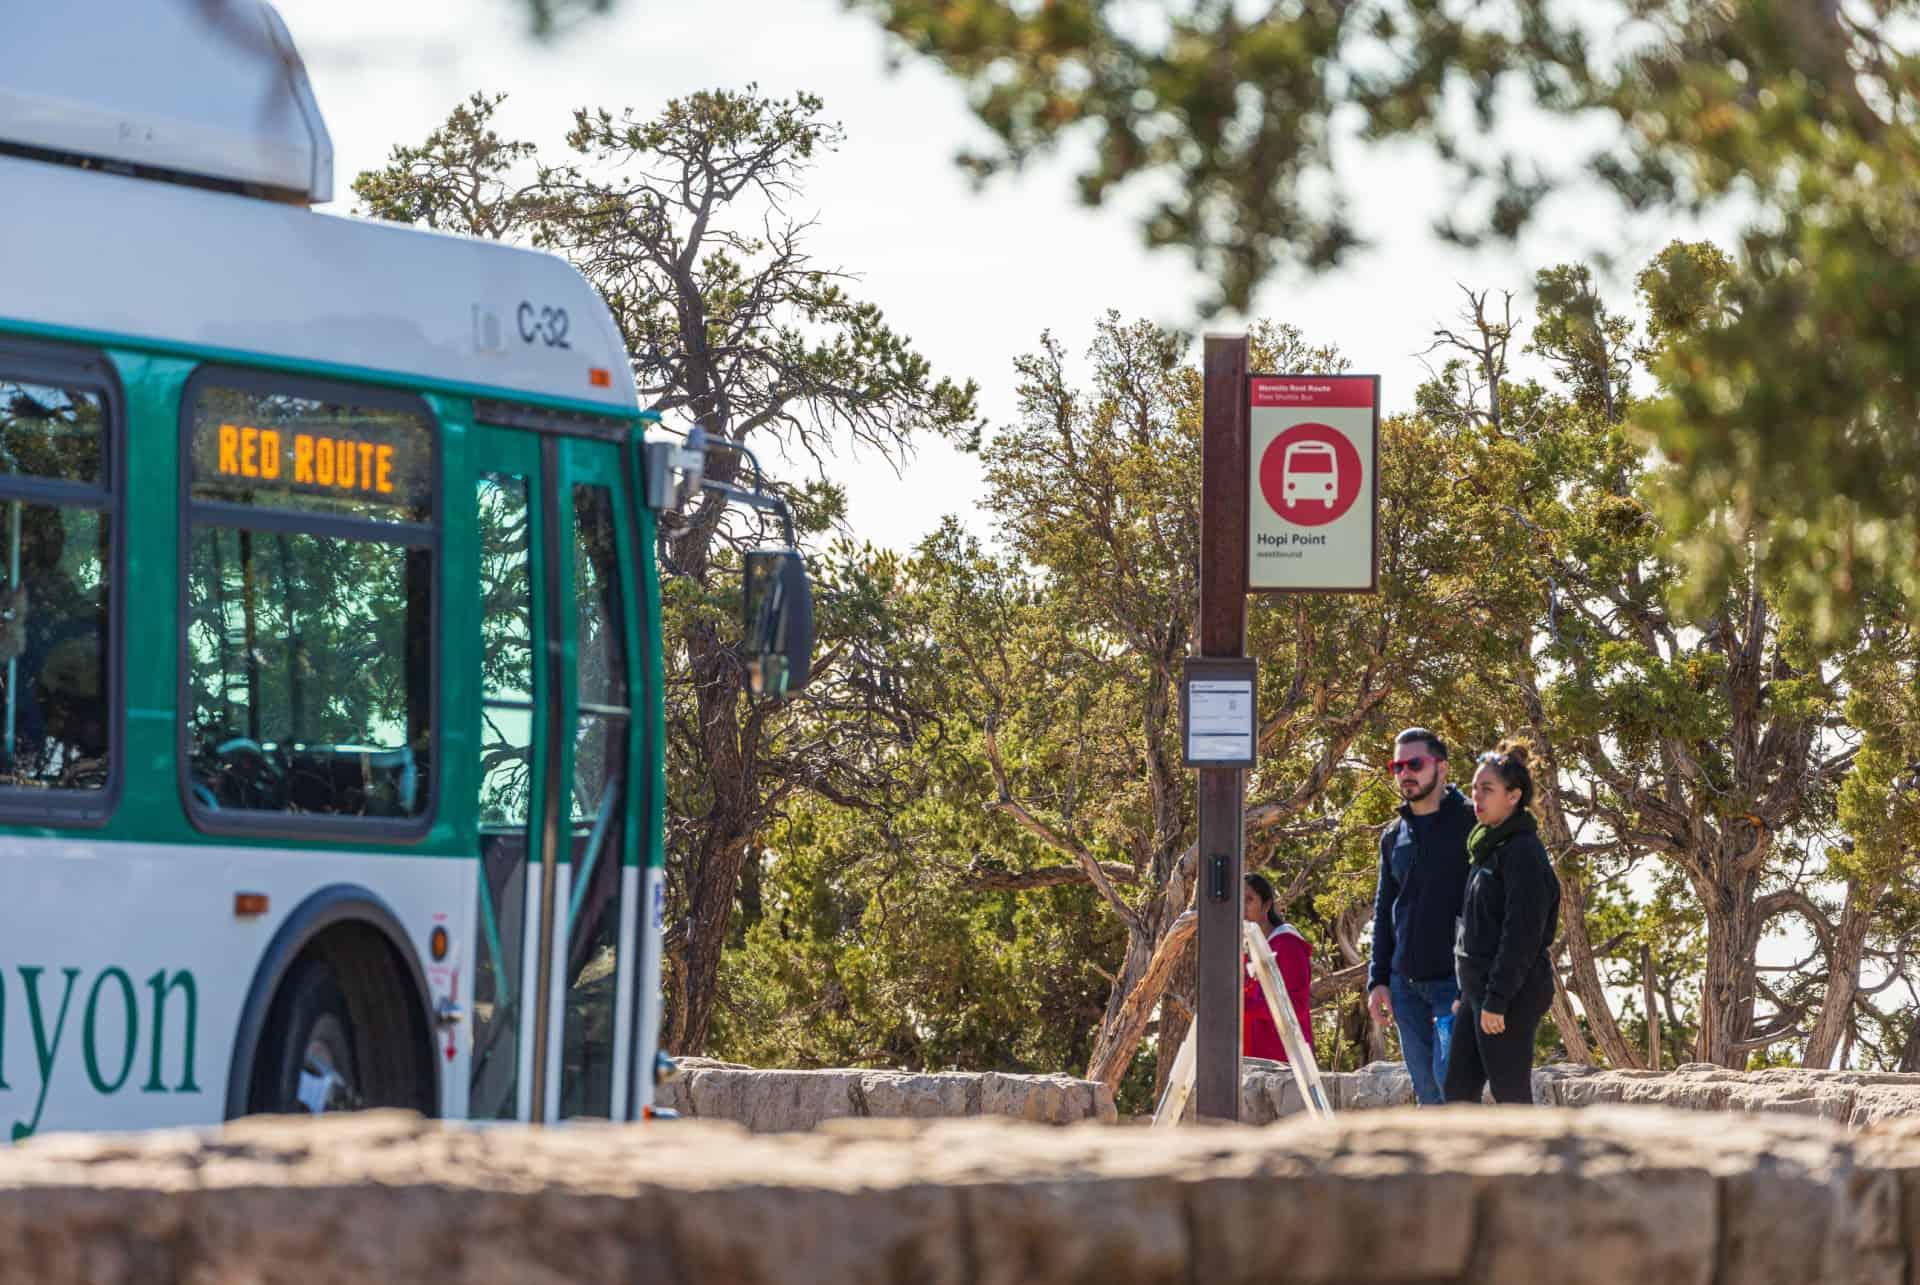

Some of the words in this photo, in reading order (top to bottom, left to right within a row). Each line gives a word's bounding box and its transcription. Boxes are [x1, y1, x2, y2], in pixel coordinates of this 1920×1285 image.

[517, 299, 571, 351] C-32
[219, 424, 280, 480] RED
[294, 433, 393, 494] ROUTE
[1257, 533, 1288, 548] Hopi
[1292, 533, 1326, 545] Point
[0, 965, 202, 1142] yon
